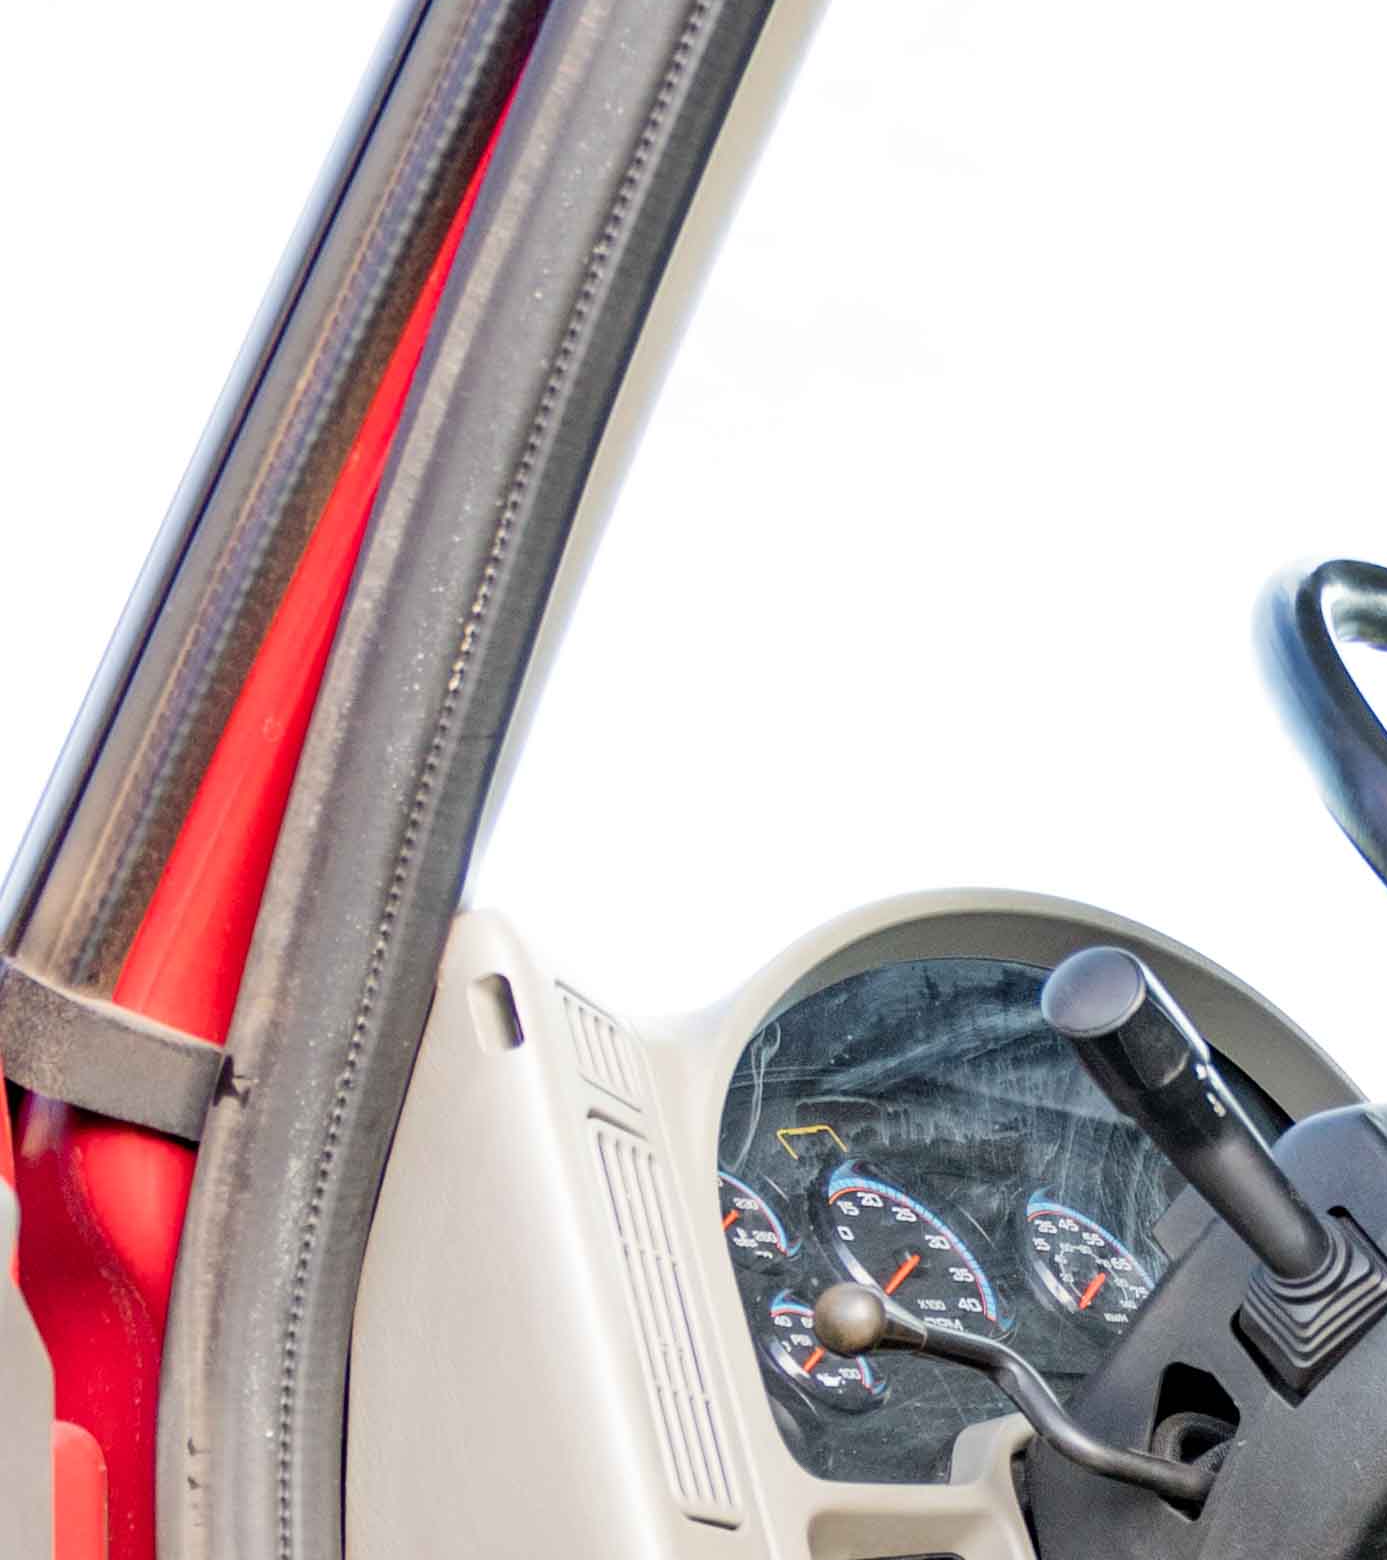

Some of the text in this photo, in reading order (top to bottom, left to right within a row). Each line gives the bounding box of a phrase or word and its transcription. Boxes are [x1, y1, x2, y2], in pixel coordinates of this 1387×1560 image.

[856, 1191, 884, 1208] 20
[837, 1201, 860, 1216] 15
[836, 1225, 855, 1241] 0
[957, 1297, 983, 1313] 40
